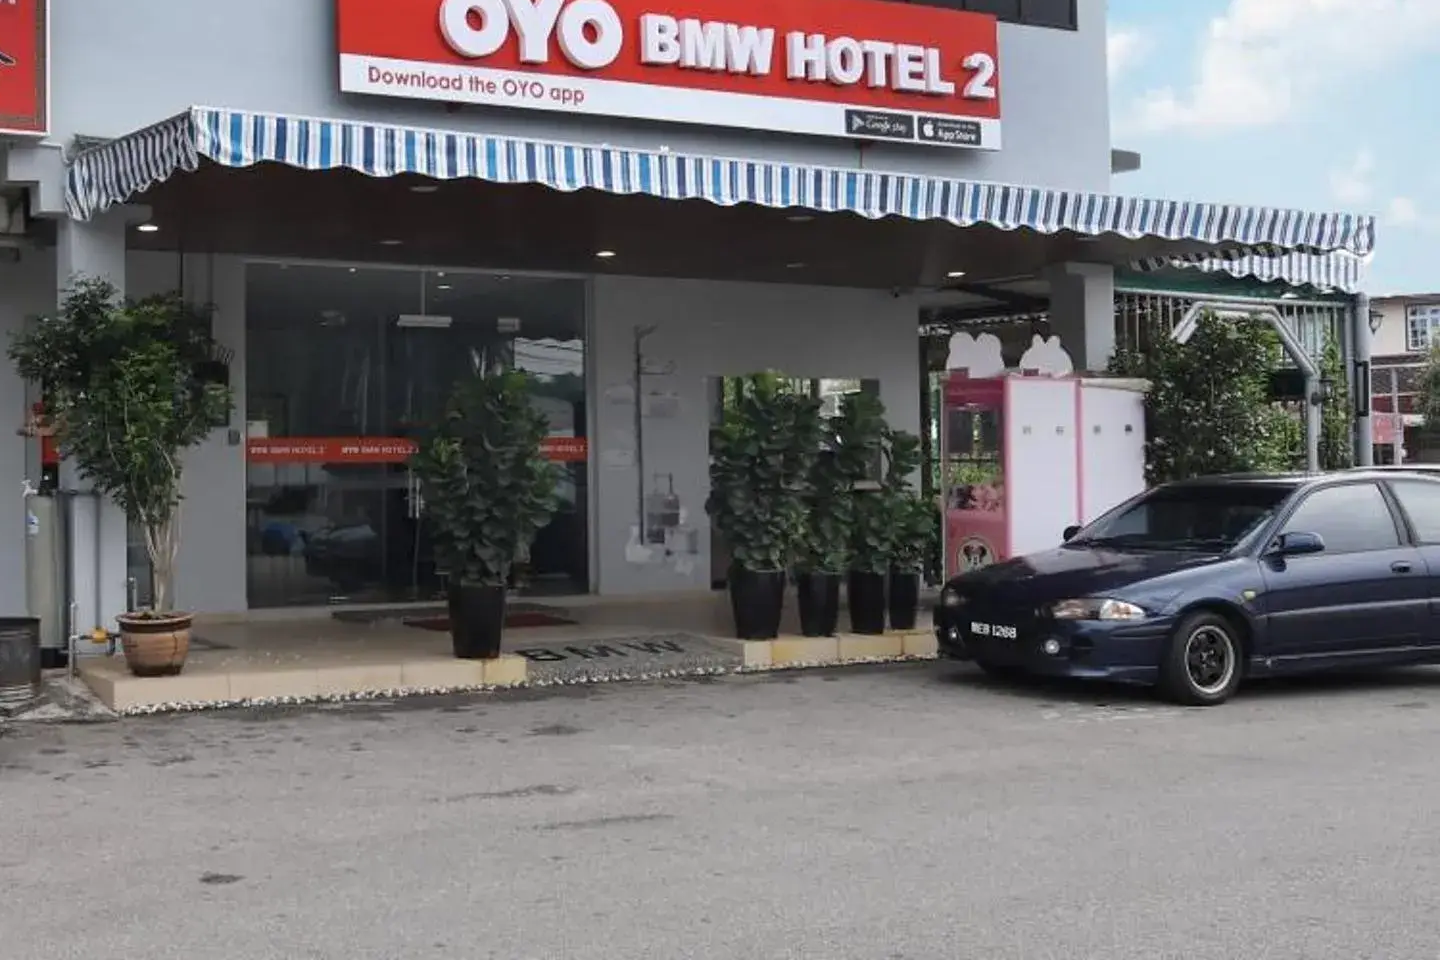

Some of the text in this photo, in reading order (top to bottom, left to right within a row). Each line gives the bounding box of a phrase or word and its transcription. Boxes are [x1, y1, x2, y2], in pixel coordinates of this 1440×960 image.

[368, 66, 585, 107] Download the OYO app
[639, 12, 775, 76] BMW
[785, 30, 956, 96] HOTEL
[962, 51, 996, 100] 2
